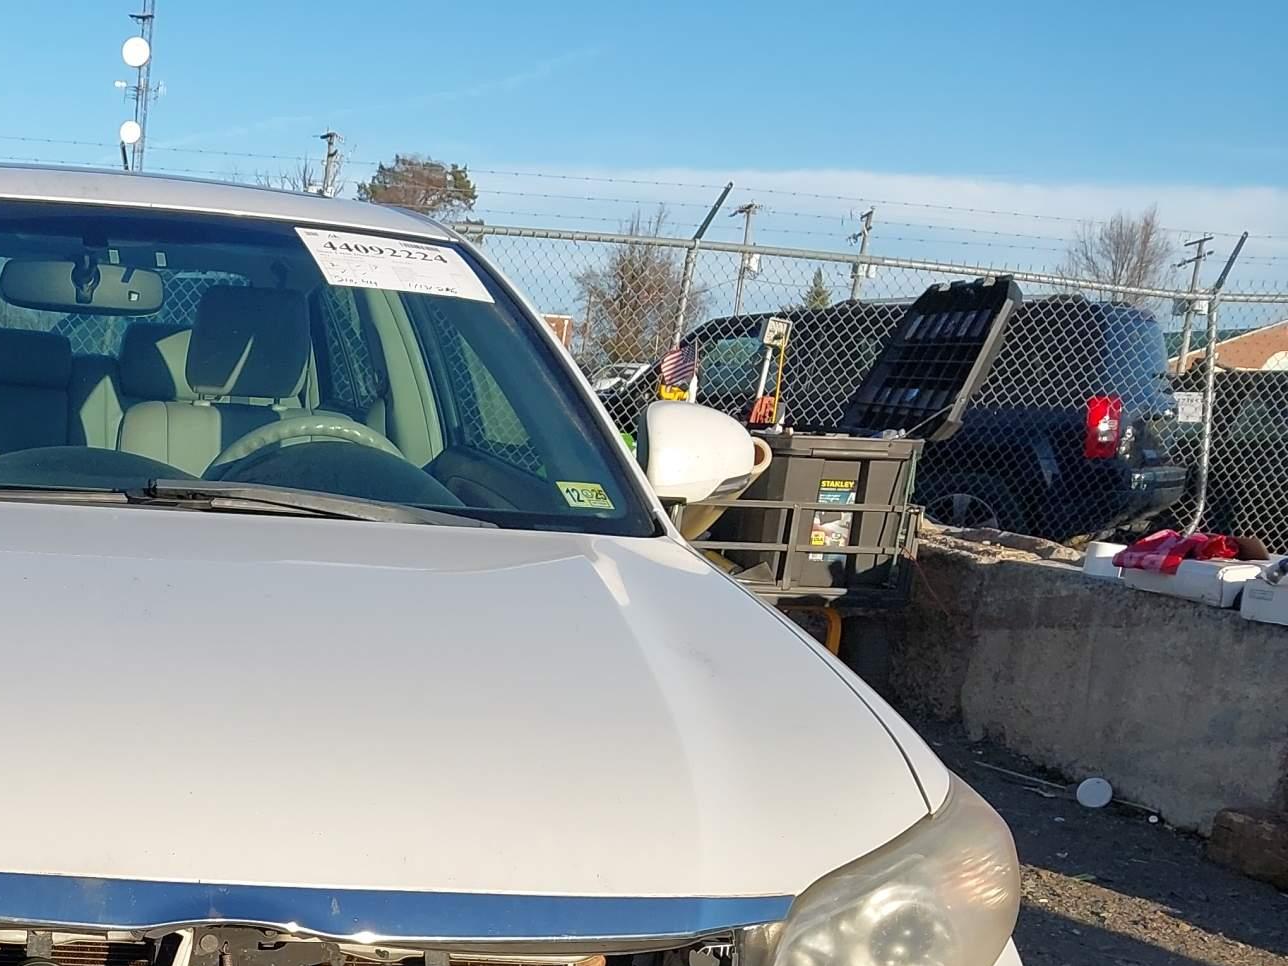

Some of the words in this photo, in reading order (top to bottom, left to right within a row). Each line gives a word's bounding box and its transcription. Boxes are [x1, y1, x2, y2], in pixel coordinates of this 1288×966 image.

[323, 241, 448, 264] 44092224
[820, 480, 855, 488] STANLEY
[565, 487, 585, 503] 12
[590, 488, 608, 501] 25
